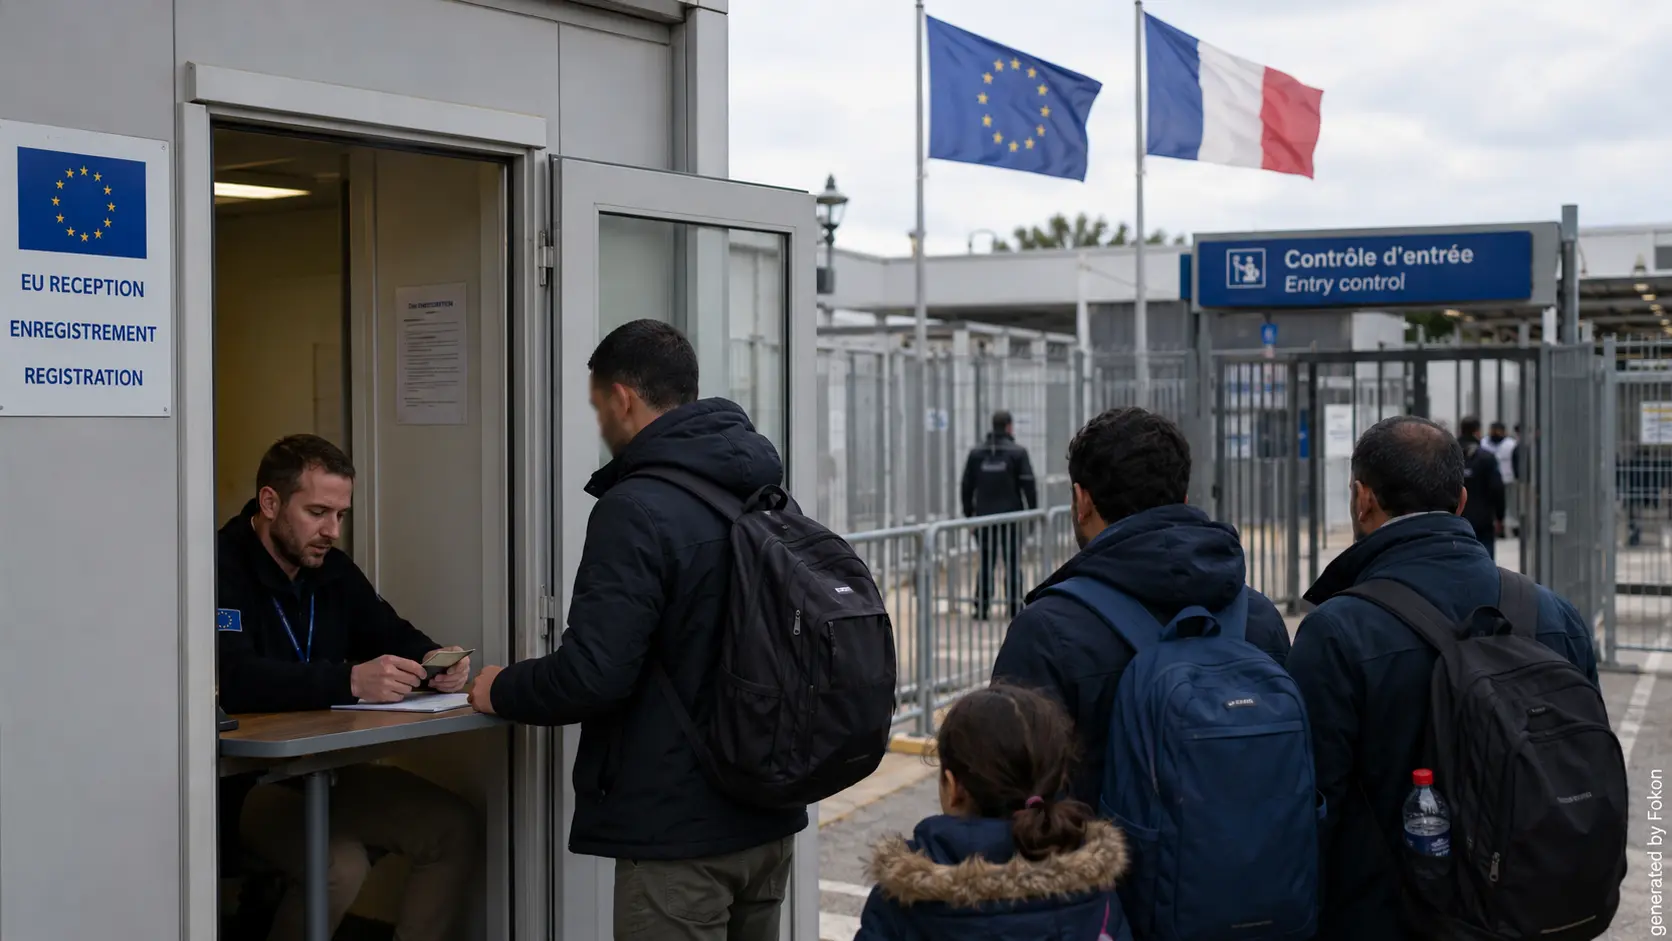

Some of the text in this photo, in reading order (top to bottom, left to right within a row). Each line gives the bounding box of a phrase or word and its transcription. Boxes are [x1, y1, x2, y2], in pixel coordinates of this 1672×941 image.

[1284, 244, 1475, 269] Contrôle d'entrée
[21, 273, 145, 298] EU RECEPTION
[1285, 272, 1406, 296] Entry control
[10, 320, 157, 343] ENREGISTREMENT
[24, 367, 144, 387] REGISTRATION
